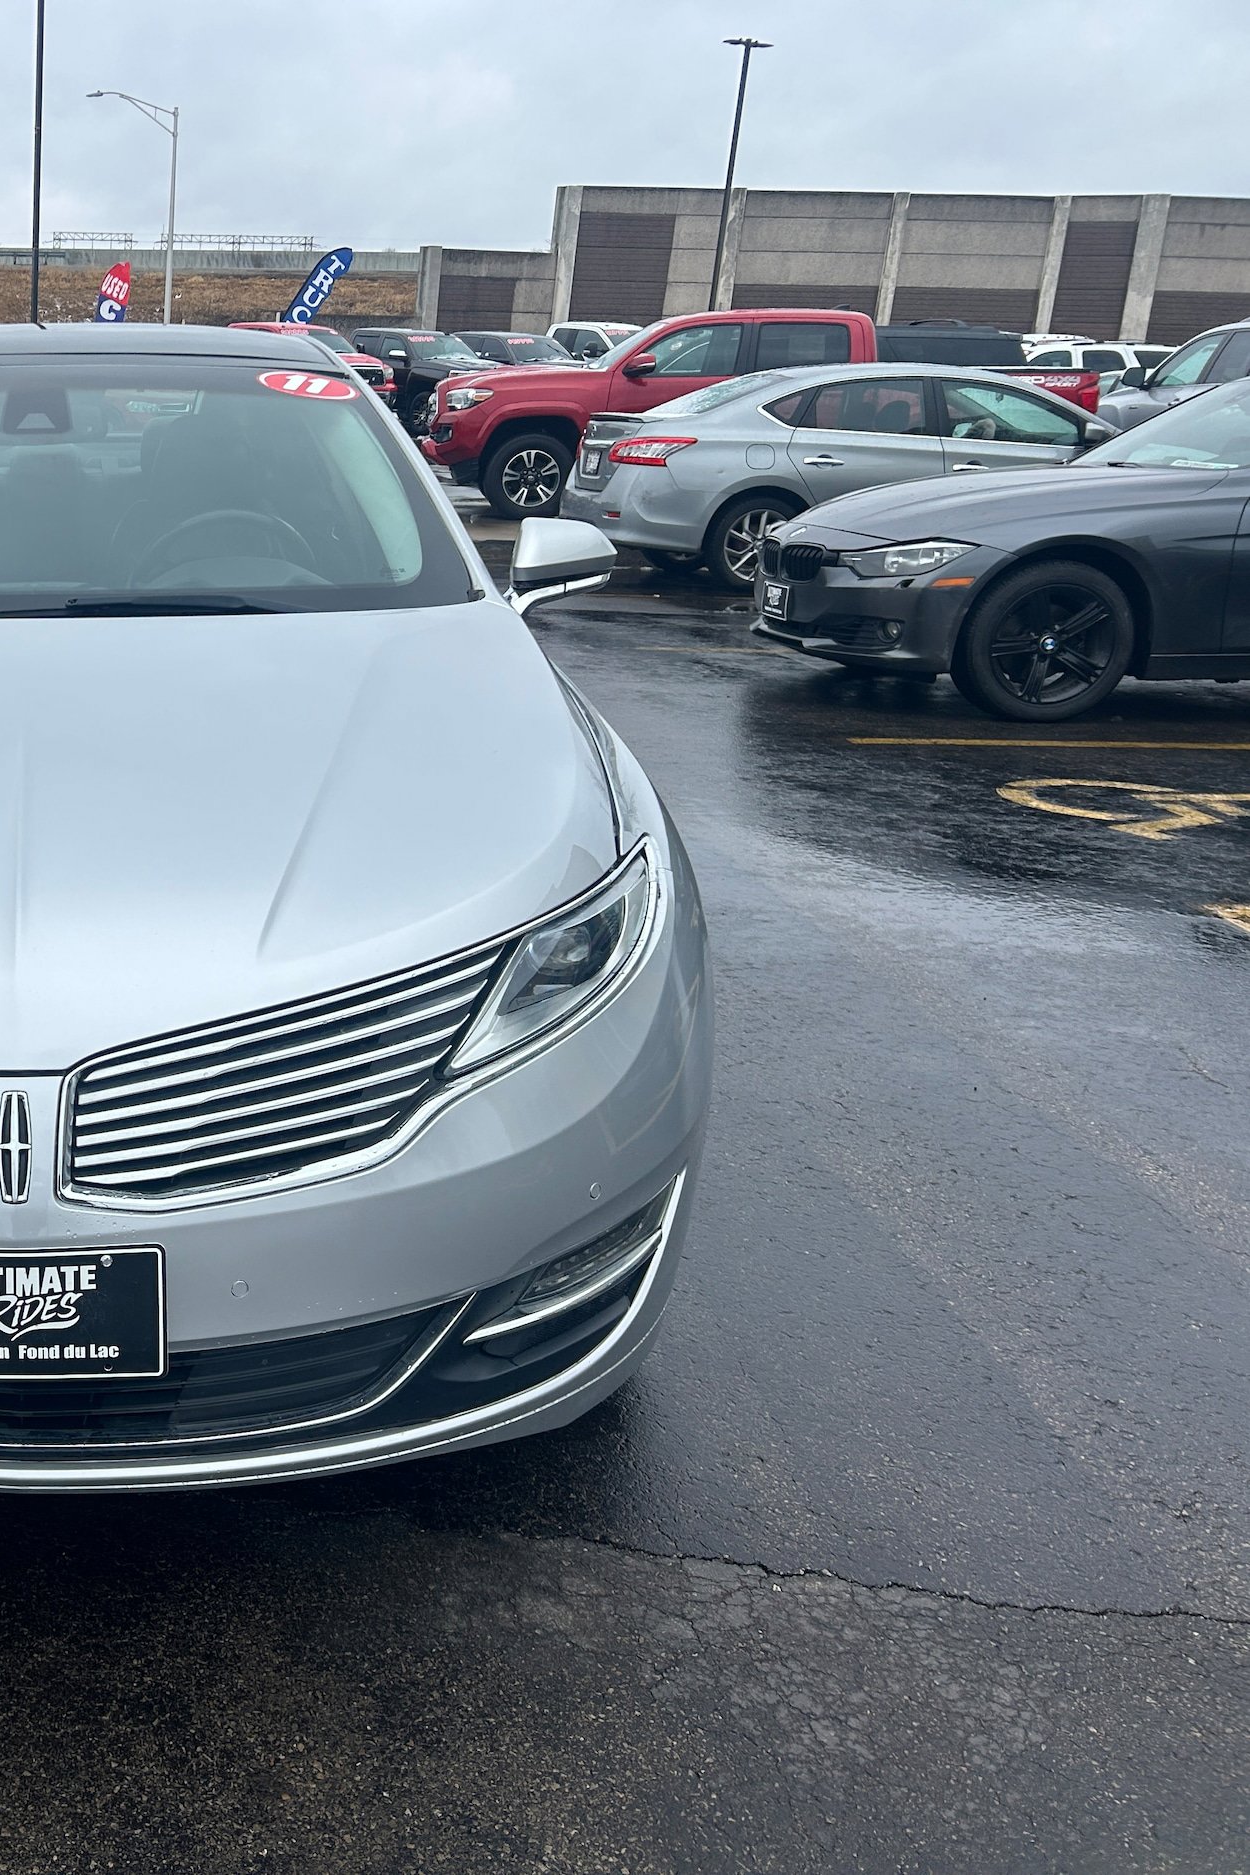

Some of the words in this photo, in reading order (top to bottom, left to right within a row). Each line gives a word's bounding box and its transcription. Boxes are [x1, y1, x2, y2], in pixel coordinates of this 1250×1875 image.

[101, 274, 129, 301] USED
[282, 374, 331, 394] 11
[18, 1345, 60, 1360] Fond
[64, 1345, 85, 1359] du
[90, 1344, 120, 1359] Lac
